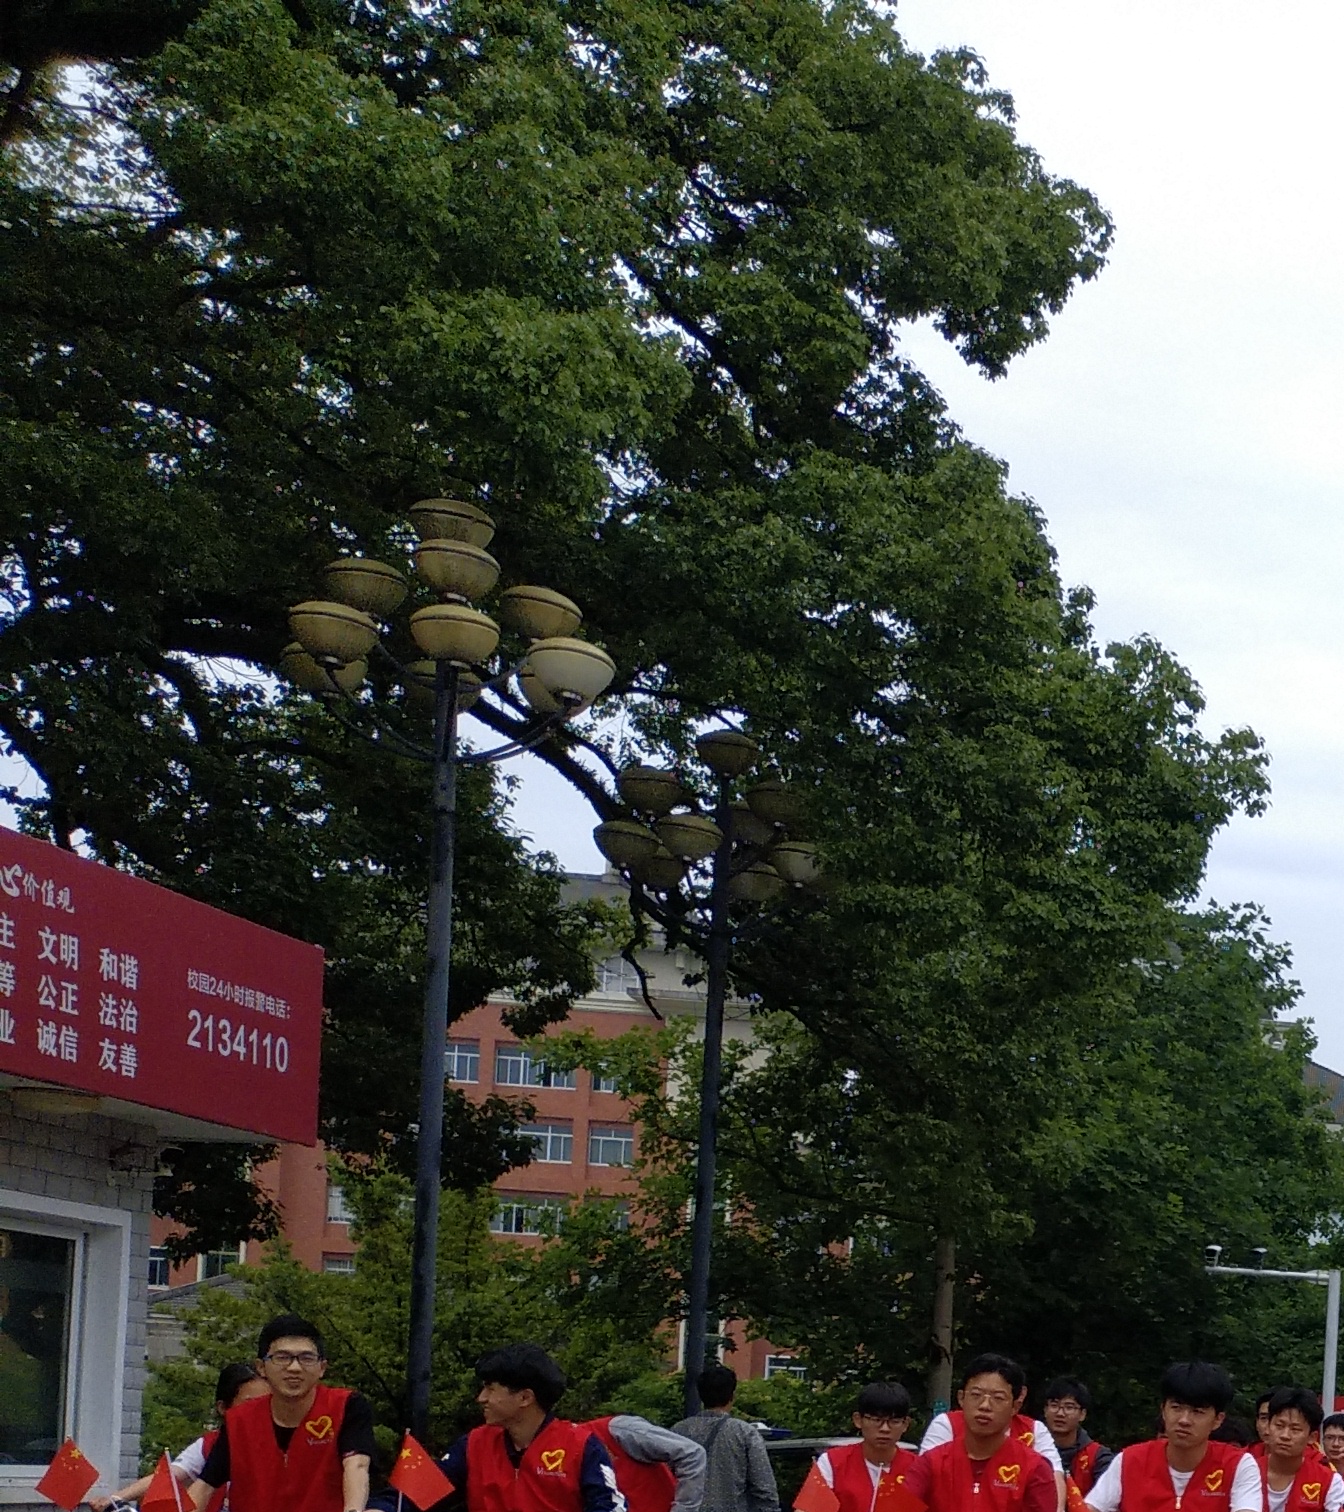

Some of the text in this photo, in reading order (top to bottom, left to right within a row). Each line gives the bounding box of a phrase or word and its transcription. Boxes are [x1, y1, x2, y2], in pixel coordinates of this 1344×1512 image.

[37, 925, 79, 972] 文明
[99, 948, 139, 991] 和谐
[37, 974, 79, 1016] 公正
[99, 991, 138, 1035] 法治
[36, 1018, 79, 1064] 诚信
[98, 1037, 138, 1079] 友善
[186, 1009, 289, 1073] 2134110
